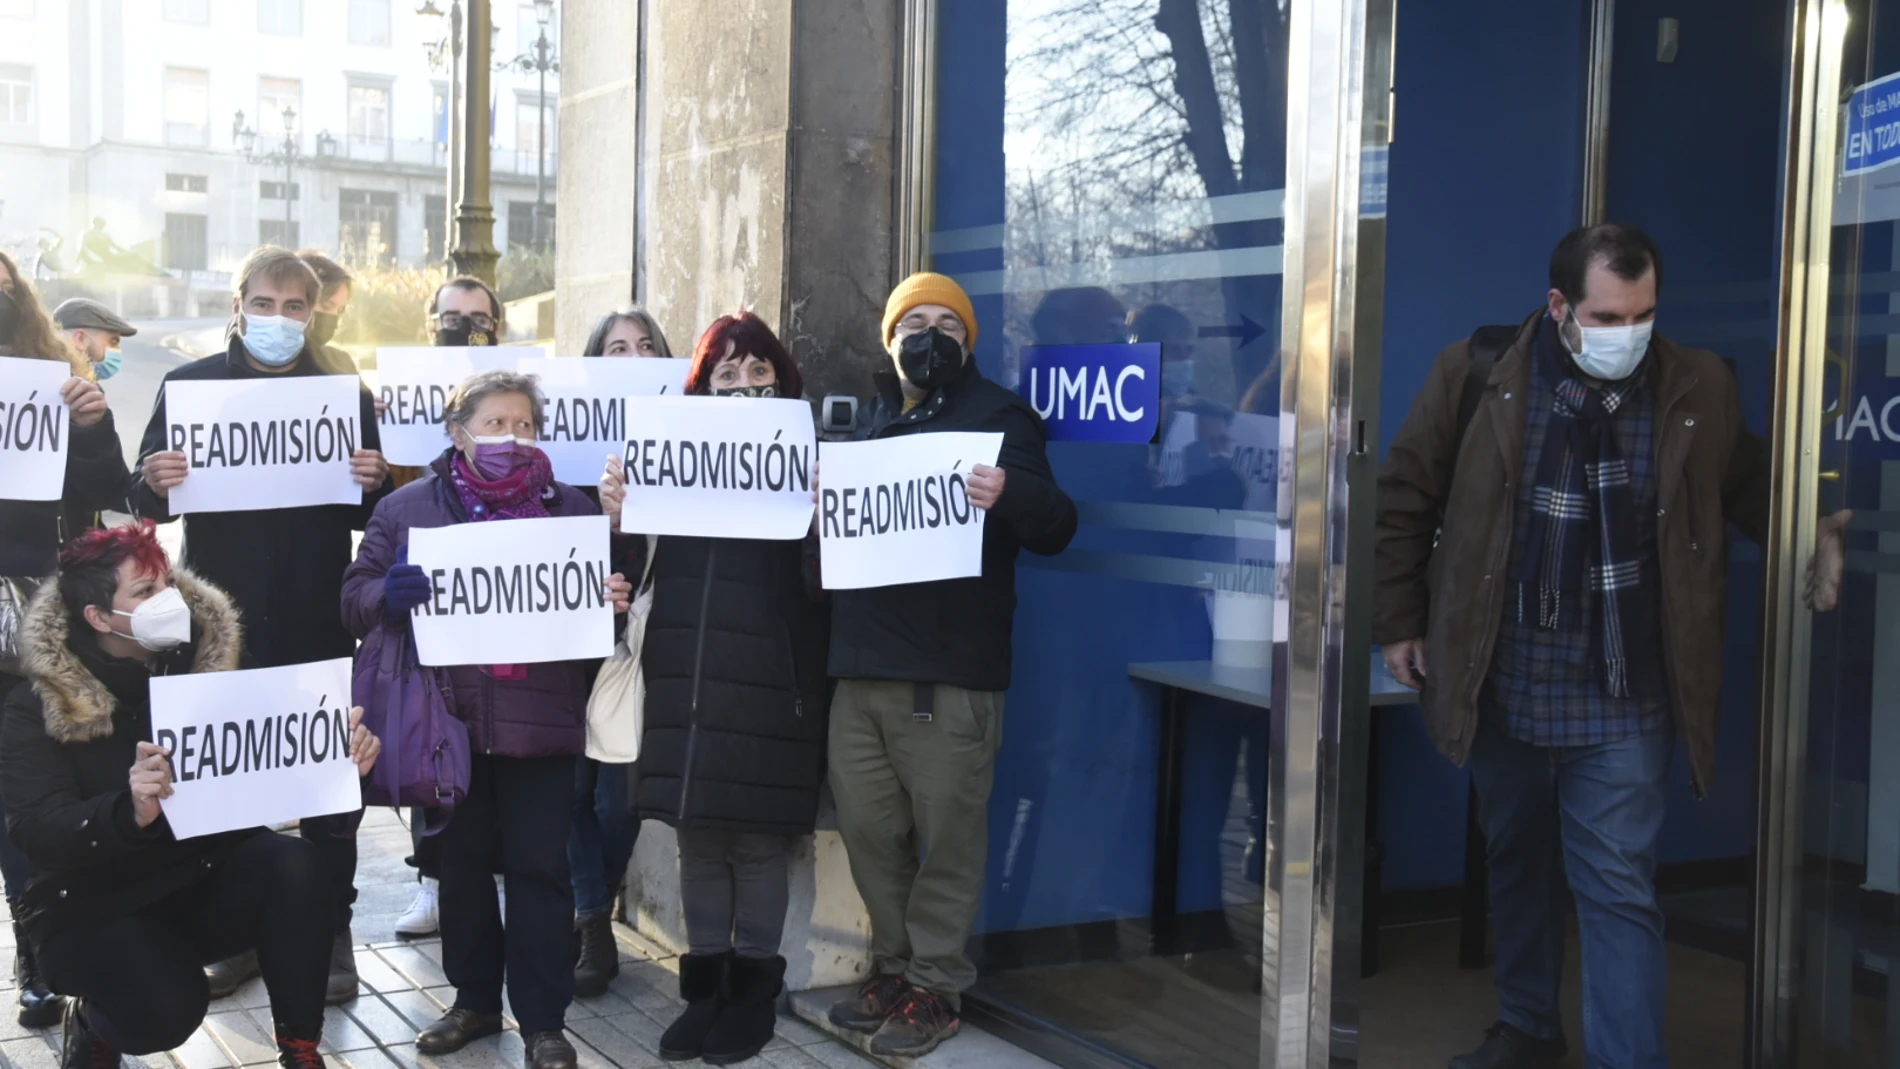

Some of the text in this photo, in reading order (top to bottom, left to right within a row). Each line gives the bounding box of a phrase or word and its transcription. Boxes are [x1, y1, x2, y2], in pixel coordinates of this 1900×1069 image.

[1848, 129, 1873, 159] EN
[380, 384, 455, 425] READ
[1031, 365, 1145, 422] UMAC
[171, 404, 355, 468] READMISIÓN
[624, 429, 809, 492] READMISIÓN
[823, 459, 978, 539] READMISIÓ
[157, 694, 351, 784] READMISIÓN
